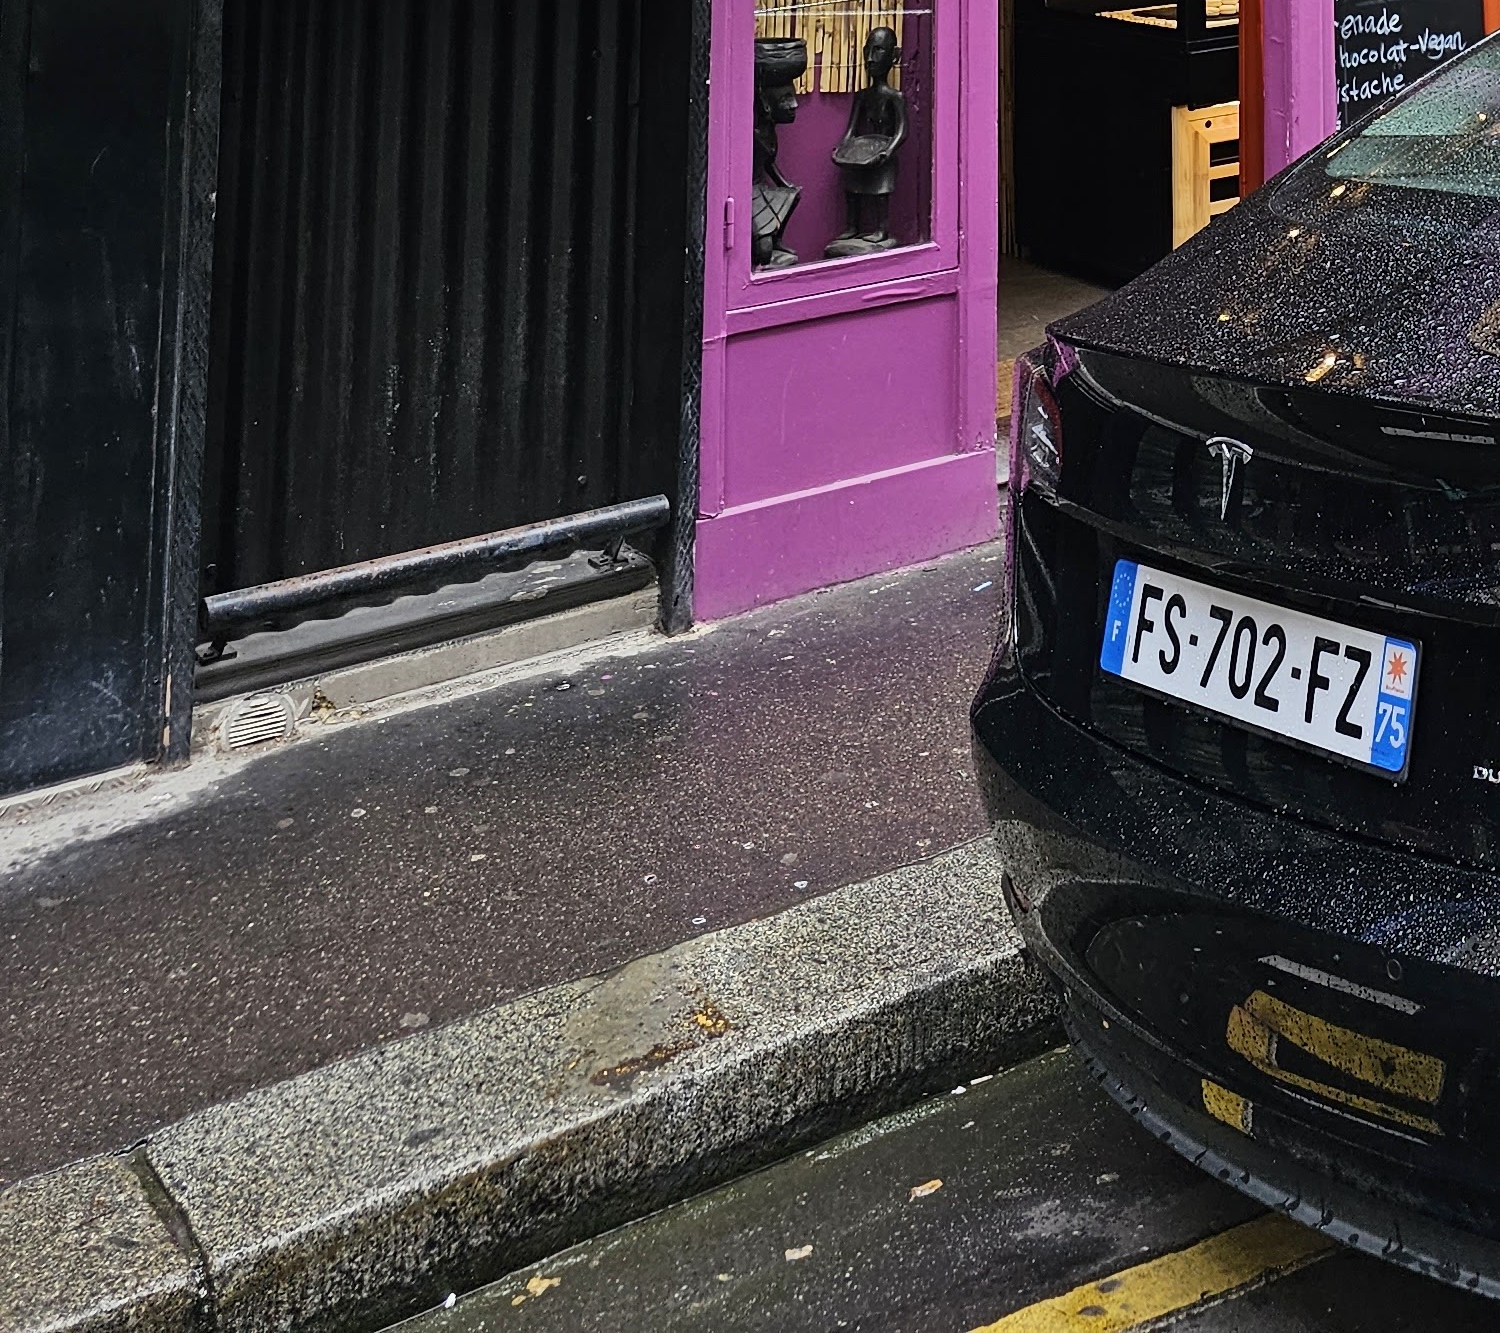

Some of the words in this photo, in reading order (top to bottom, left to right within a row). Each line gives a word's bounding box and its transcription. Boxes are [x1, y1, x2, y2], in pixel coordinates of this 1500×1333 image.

[1335, 8, 1403, 40] enade
[1337, 72, 1406, 105] istache
[1110, 618, 1122, 642] F
[1131, 582, 1374, 740] FS-702-FZ
[1374, 701, 1407, 749] 75
